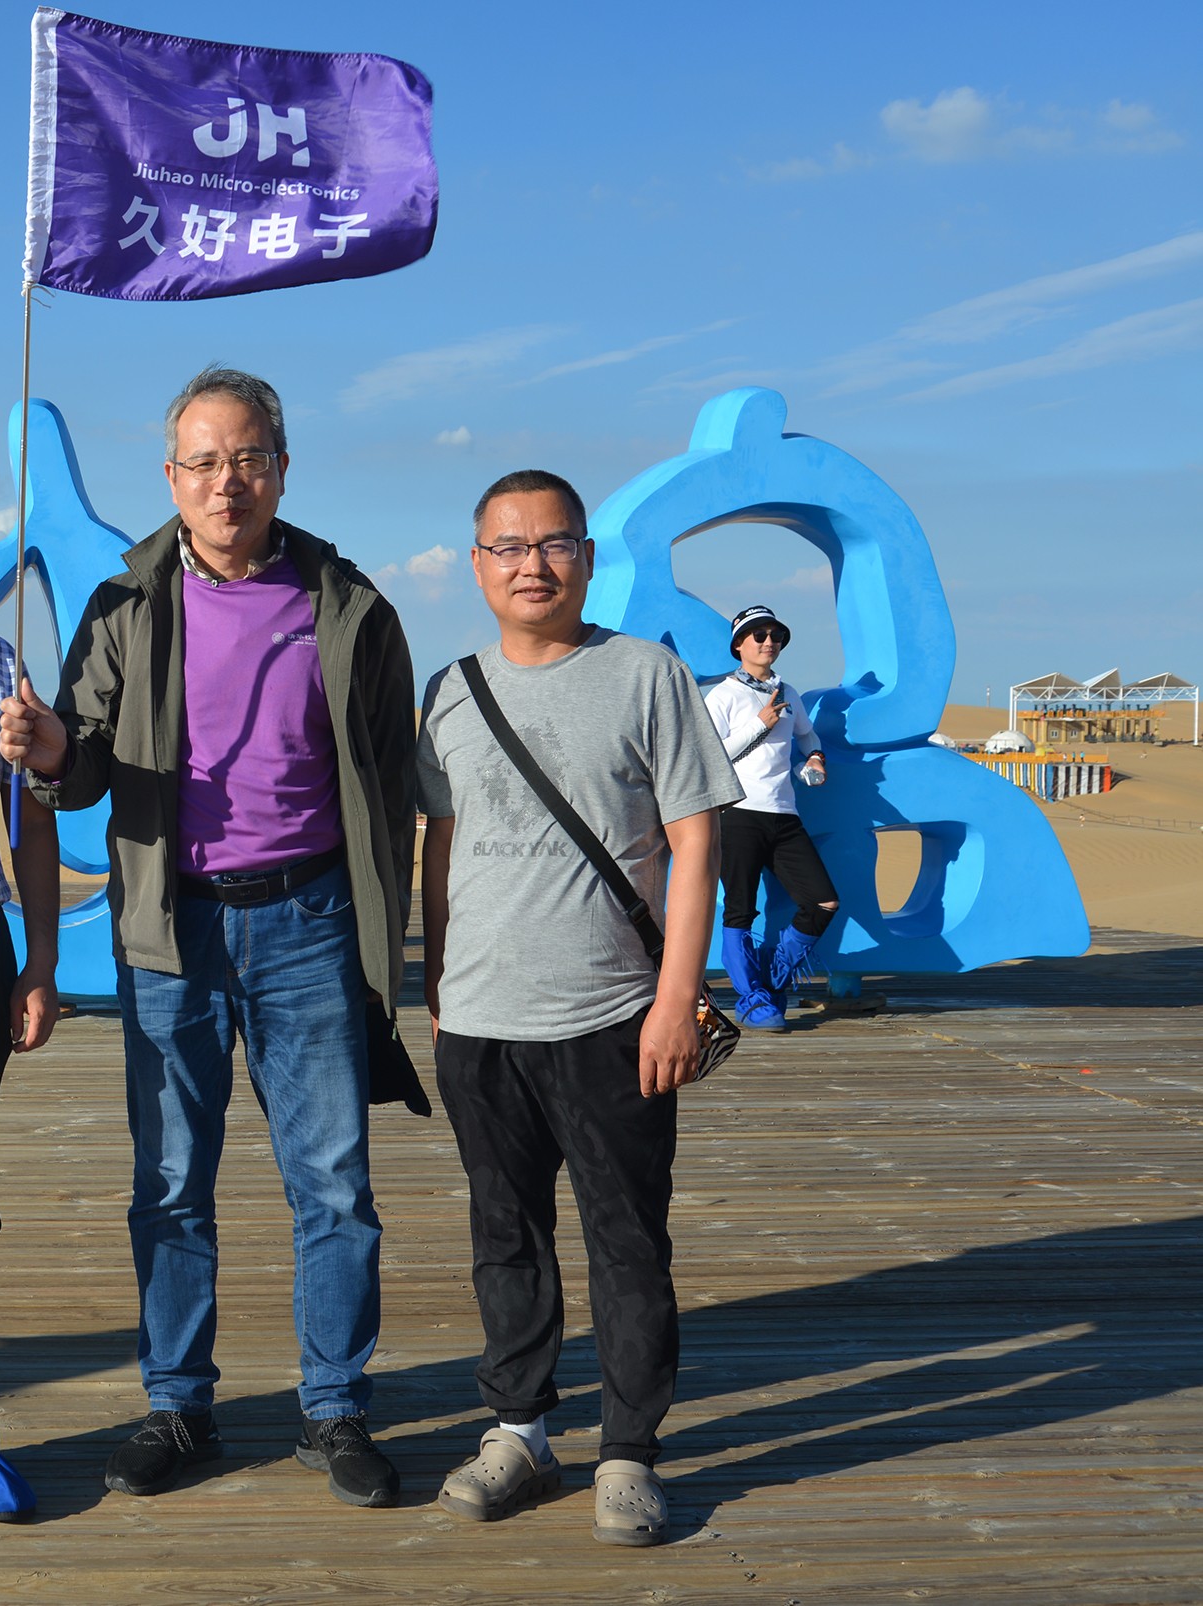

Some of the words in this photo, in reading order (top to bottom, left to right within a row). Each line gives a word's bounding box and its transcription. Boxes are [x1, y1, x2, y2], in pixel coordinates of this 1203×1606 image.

[134, 162, 194, 187] Jiuhao
[200, 173, 360, 202] Micro-electronics
[118, 196, 371, 262] 久好电子
[474, 842, 524, 857] BLACK
[529, 842, 568, 857] YAK
